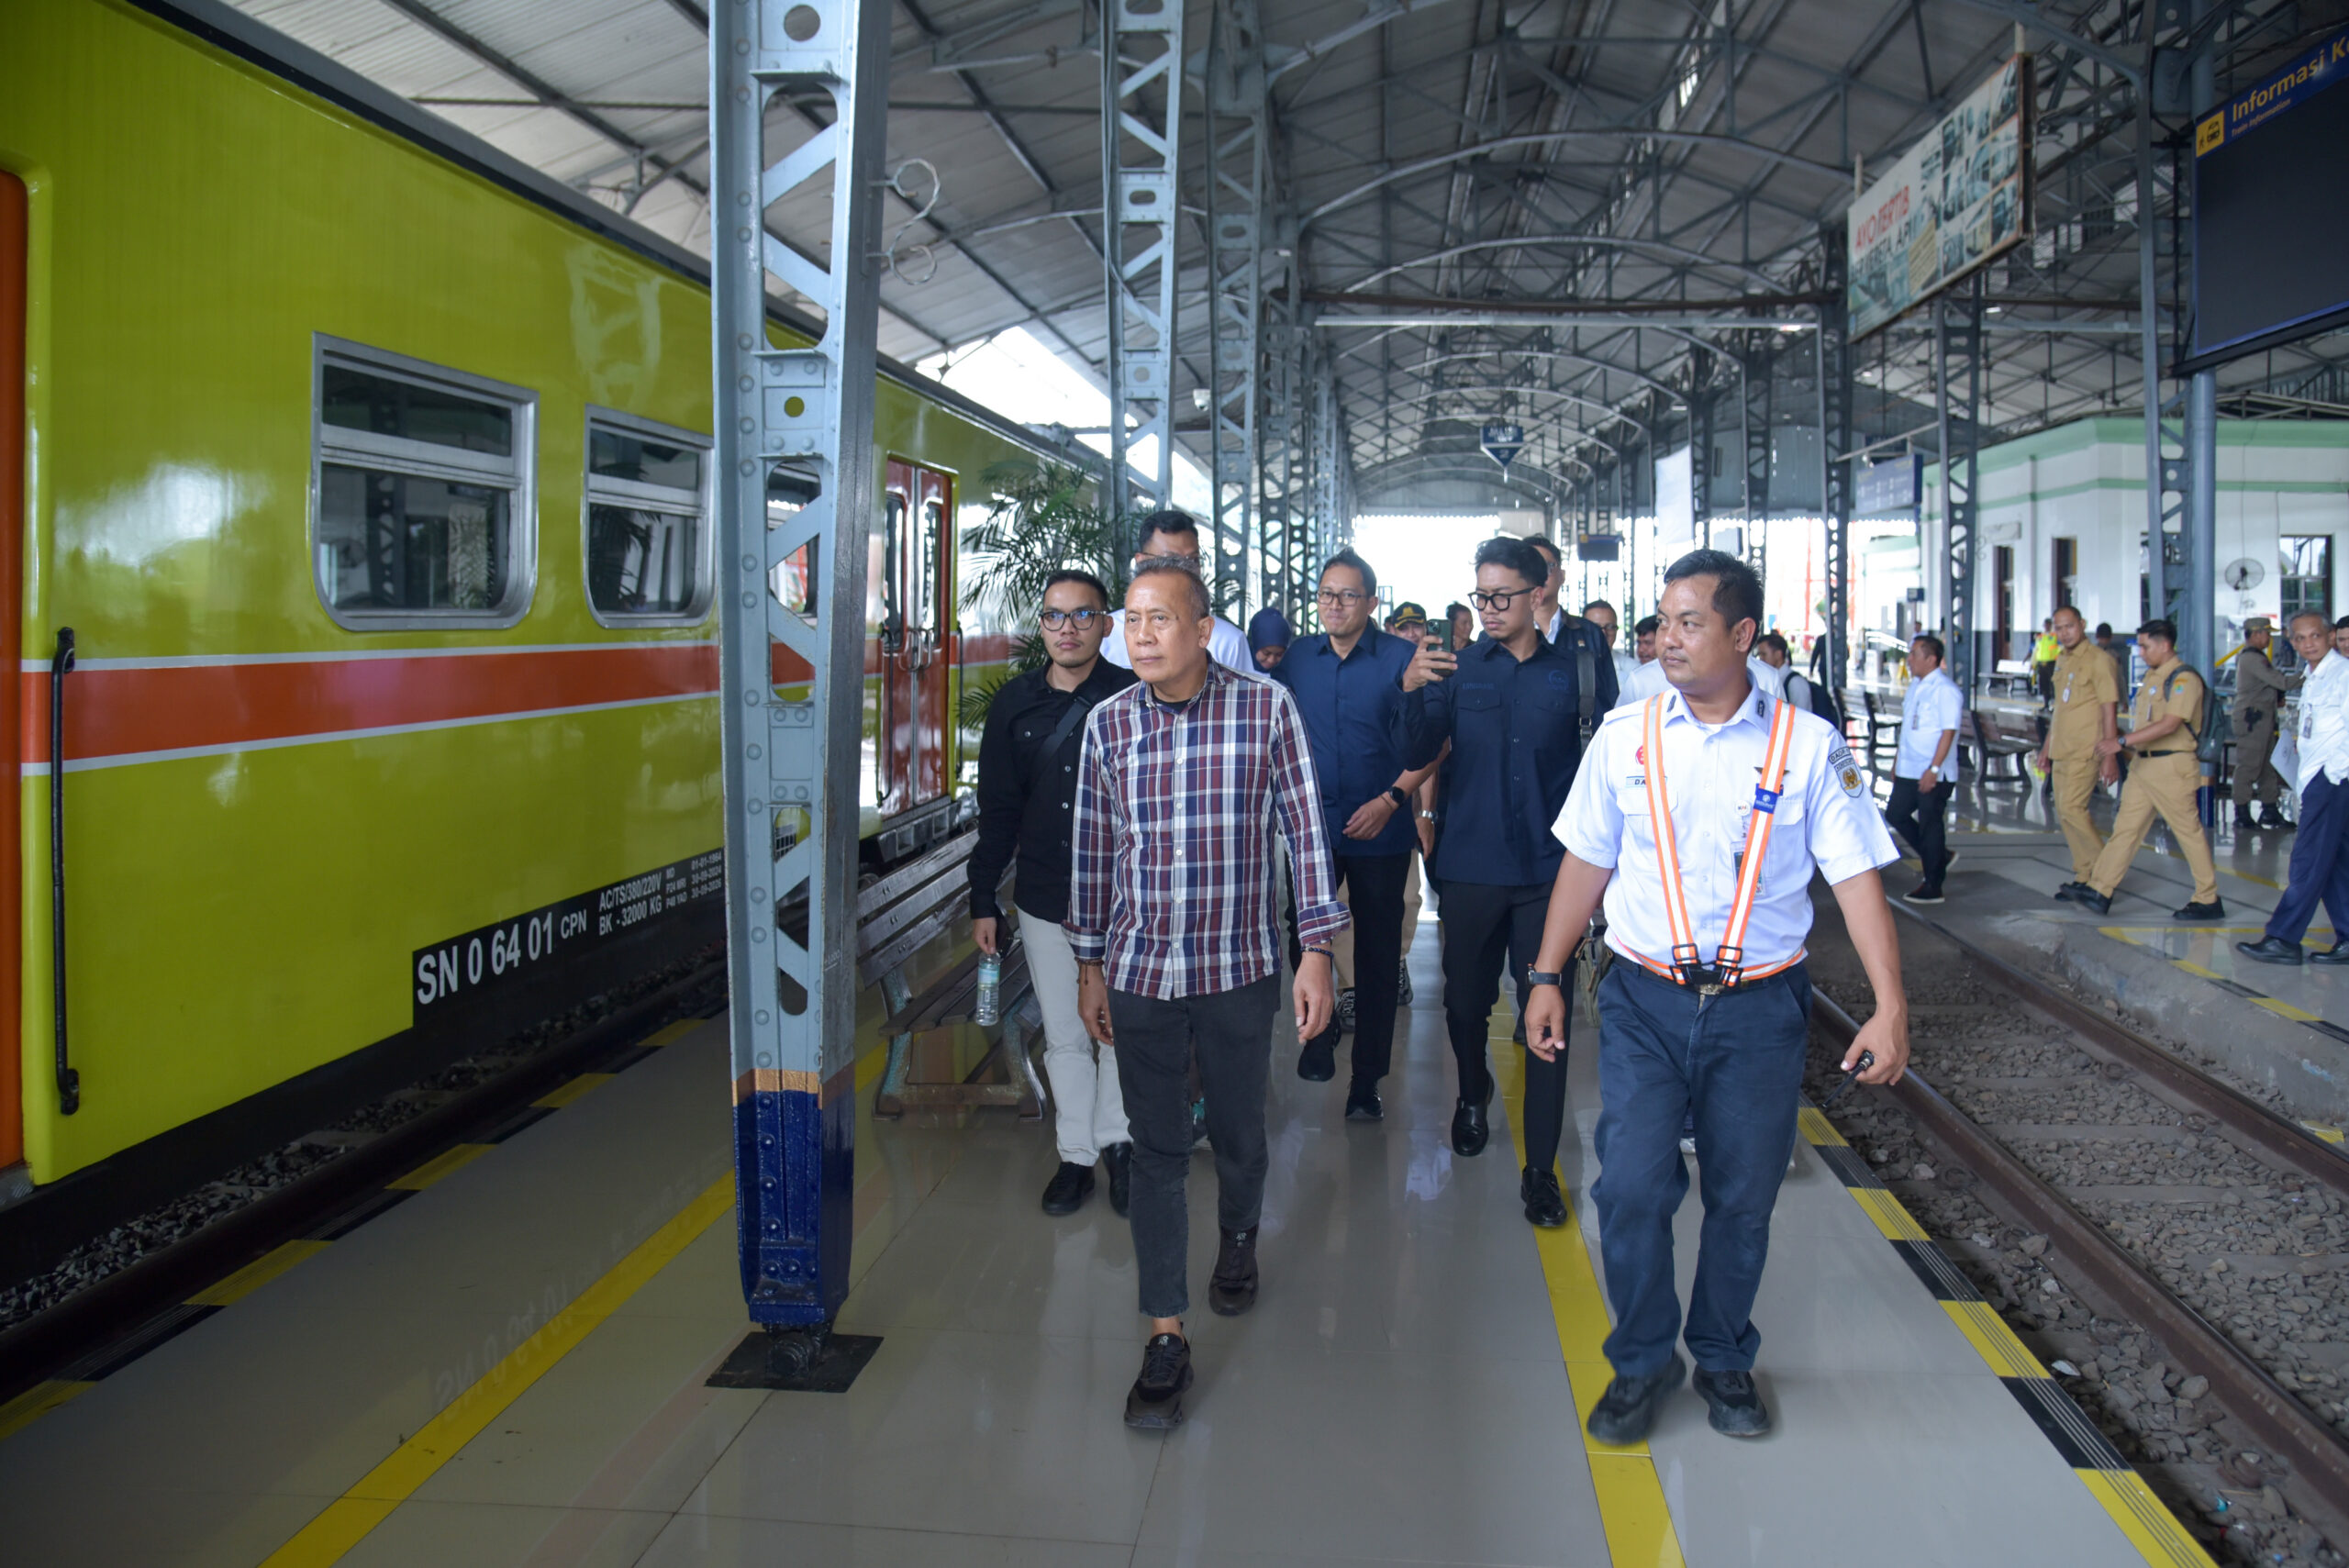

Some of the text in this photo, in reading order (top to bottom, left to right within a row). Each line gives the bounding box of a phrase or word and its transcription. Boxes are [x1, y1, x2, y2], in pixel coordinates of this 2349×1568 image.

[2232, 49, 2325, 123] Informasi
[1854, 185, 1909, 254] AYO TERTIB
[598, 872, 662, 912] AC/TS/380/220V
[598, 913, 613, 936] BK
[621, 900, 648, 927] 32000
[650, 895, 662, 916] KG
[417, 909, 587, 1005] SN 0 64 01 CPN
